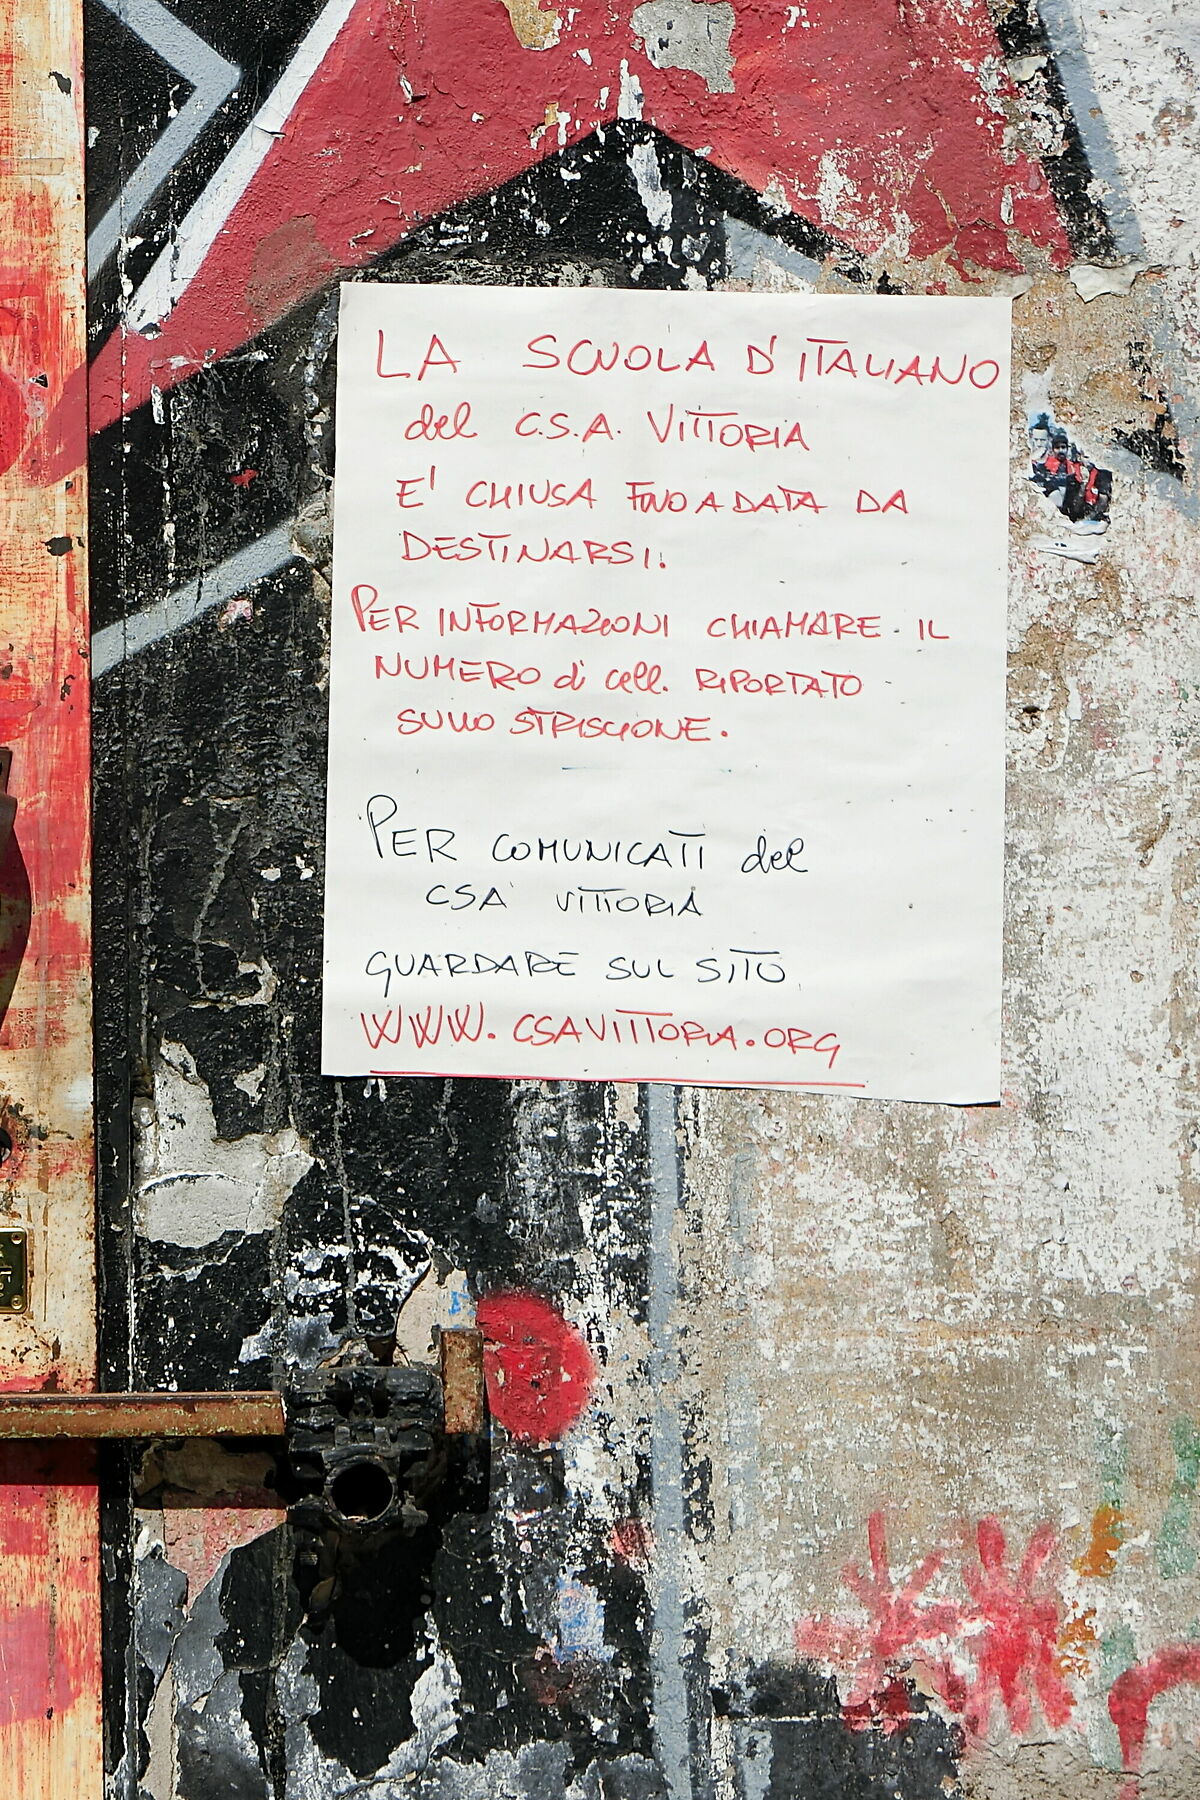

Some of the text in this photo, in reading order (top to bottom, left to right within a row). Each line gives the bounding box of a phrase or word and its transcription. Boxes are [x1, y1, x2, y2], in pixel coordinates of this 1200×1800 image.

[377, 330, 460, 381] LA
[523, 335, 715, 375] SCUOLA
[405, 402, 477, 440] del
[647, 404, 809, 452] VITTORIA
[396, 466, 435, 508] E'
[466, 479, 596, 509] CHIUSA
[695, 492, 723, 513] A
[733, 485, 827, 513] DATA
[857, 490, 908, 514] DA
[351, 584, 419, 633] PER
[707, 612, 880, 639] CHIAMARE
[919, 619, 949, 640] IL
[375, 653, 541, 690] NUMERO
[606, 662, 668, 694] cell.
[696, 669, 862, 698] RIPORTATO
[367, 795, 808, 873] PER COMUNICATI del
[426, 884, 702, 916] CSA VITTORIA
[366, 949, 785, 998] GUARDARE SUL SITO
